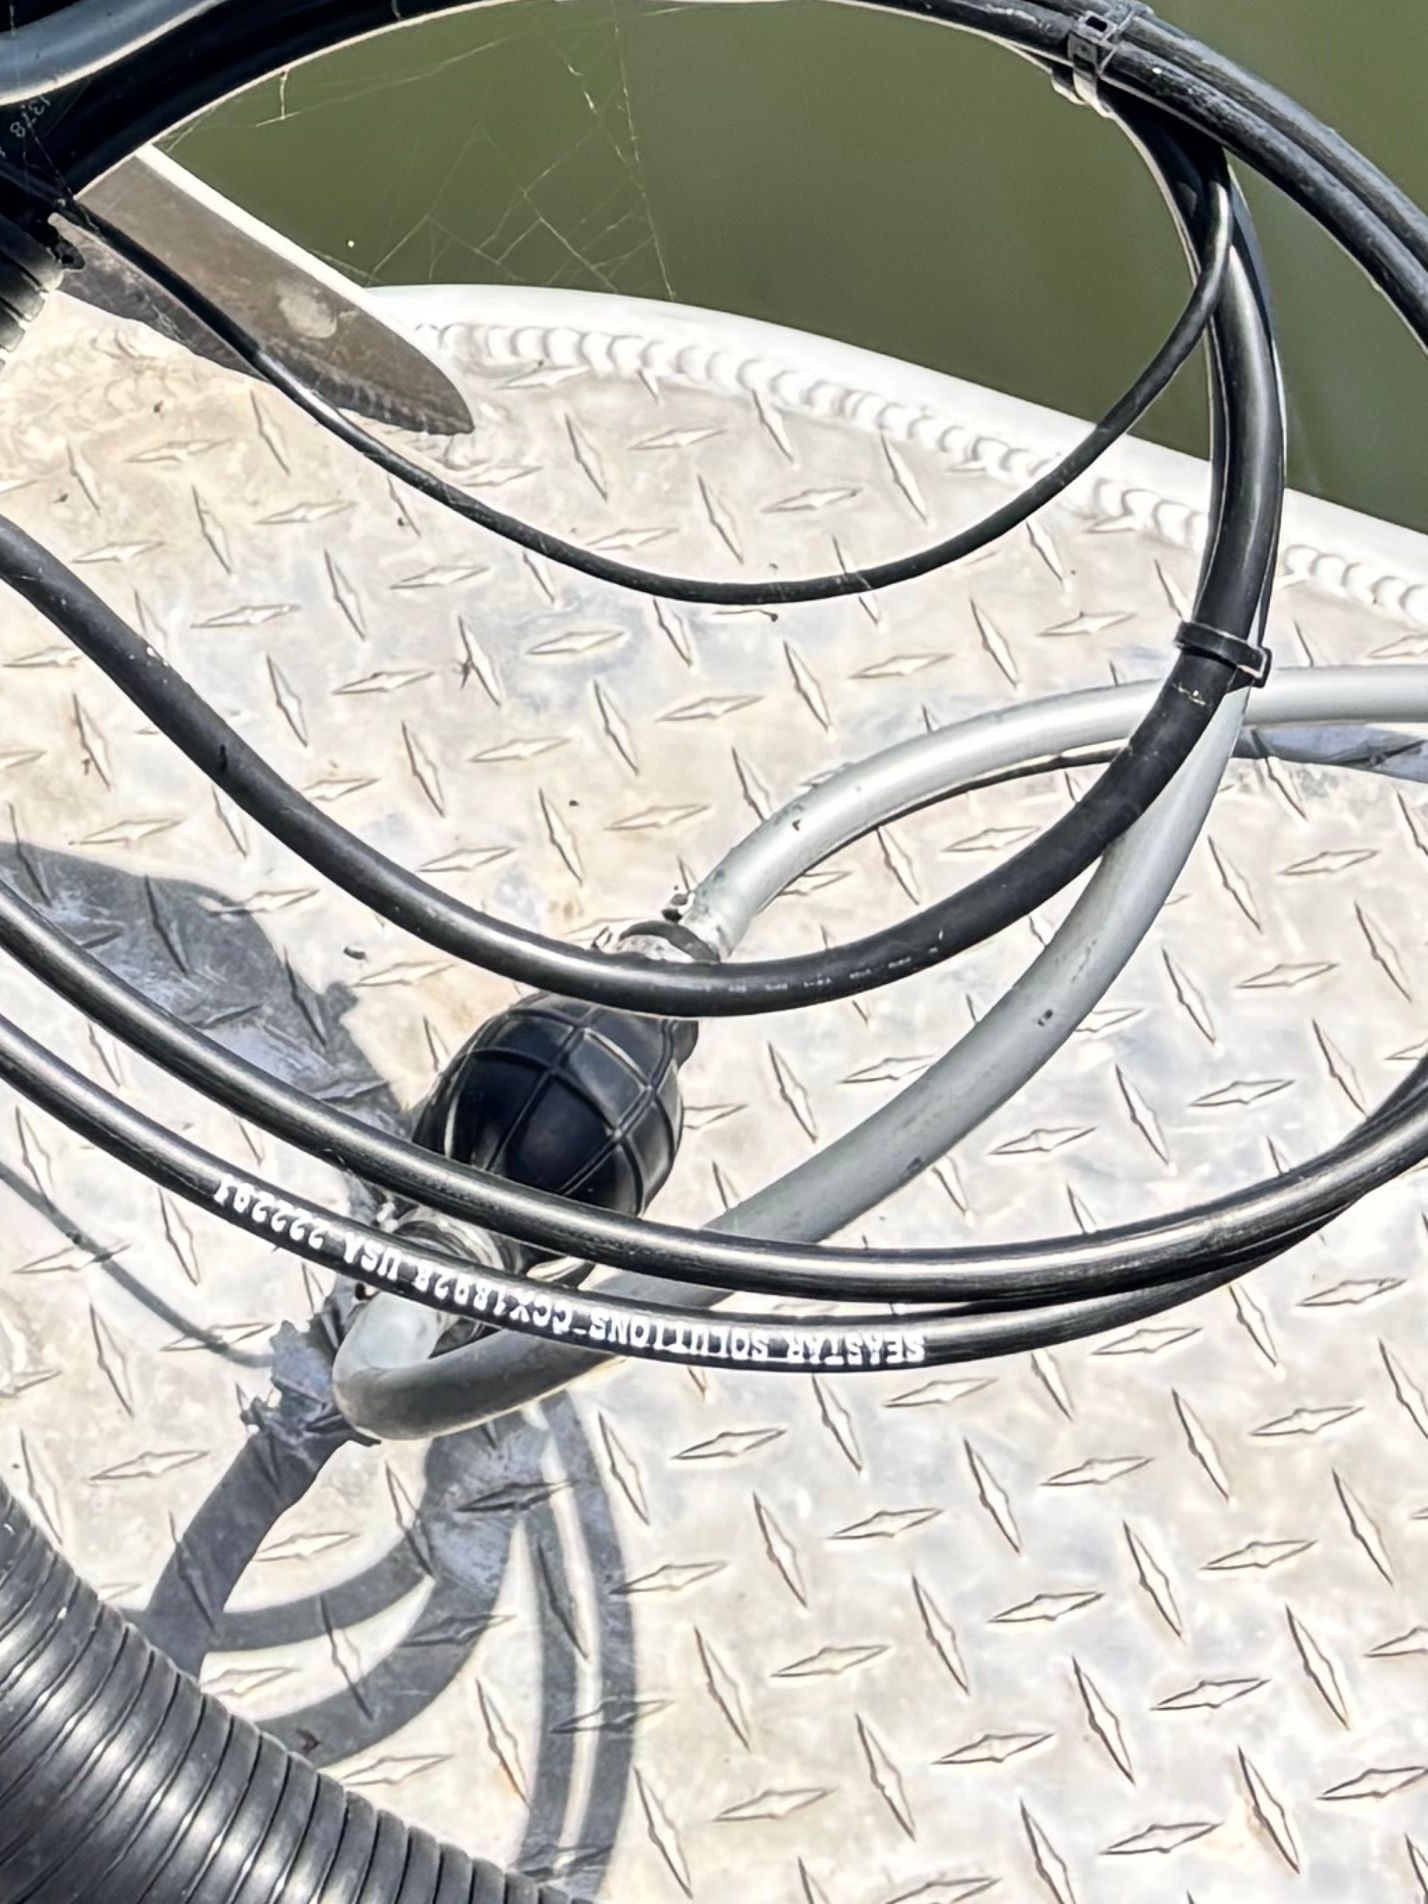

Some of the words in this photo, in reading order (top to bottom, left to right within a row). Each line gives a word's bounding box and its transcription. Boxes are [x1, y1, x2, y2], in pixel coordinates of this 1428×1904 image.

[343, 1230, 403, 1280] USA
[589, 1305, 770, 1362] SOLUTIONS
[785, 1329, 928, 1366] SEASTAR
